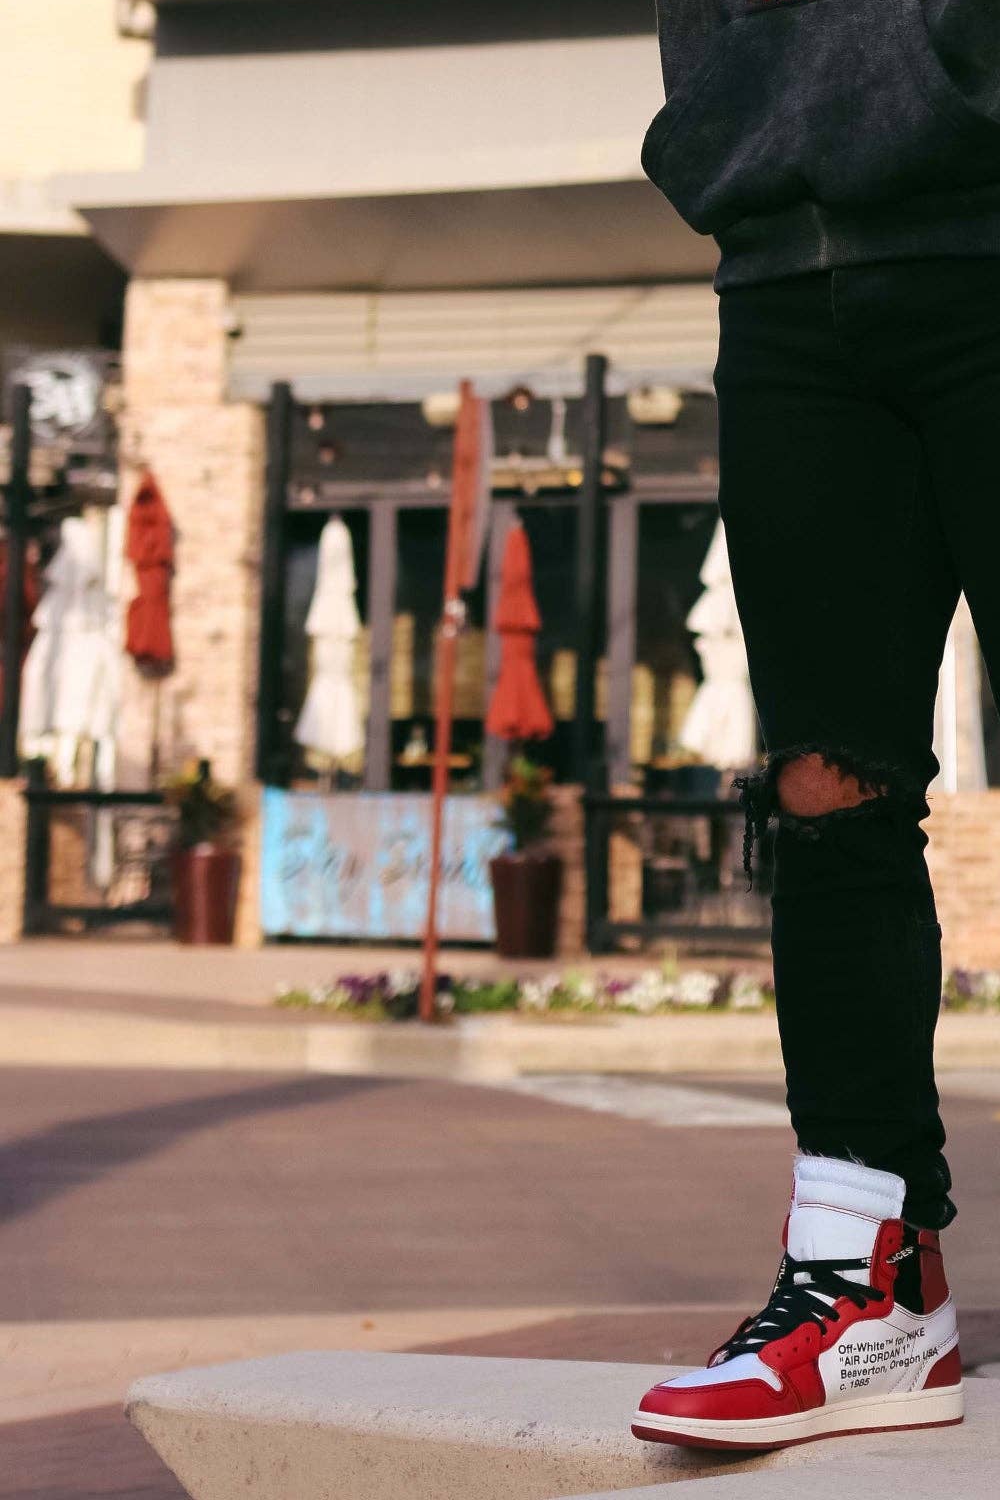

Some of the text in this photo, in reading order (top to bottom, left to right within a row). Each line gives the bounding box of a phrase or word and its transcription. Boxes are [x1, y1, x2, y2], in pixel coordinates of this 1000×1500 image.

[895, 1336, 906, 1345] for
[906, 1327, 925, 1341] NIKE
[840, 1347, 939, 1379] Beaverton, Oregon USA
[863, 1348, 901, 1364] JORDAN
[850, 1378, 870, 1389] 1985
